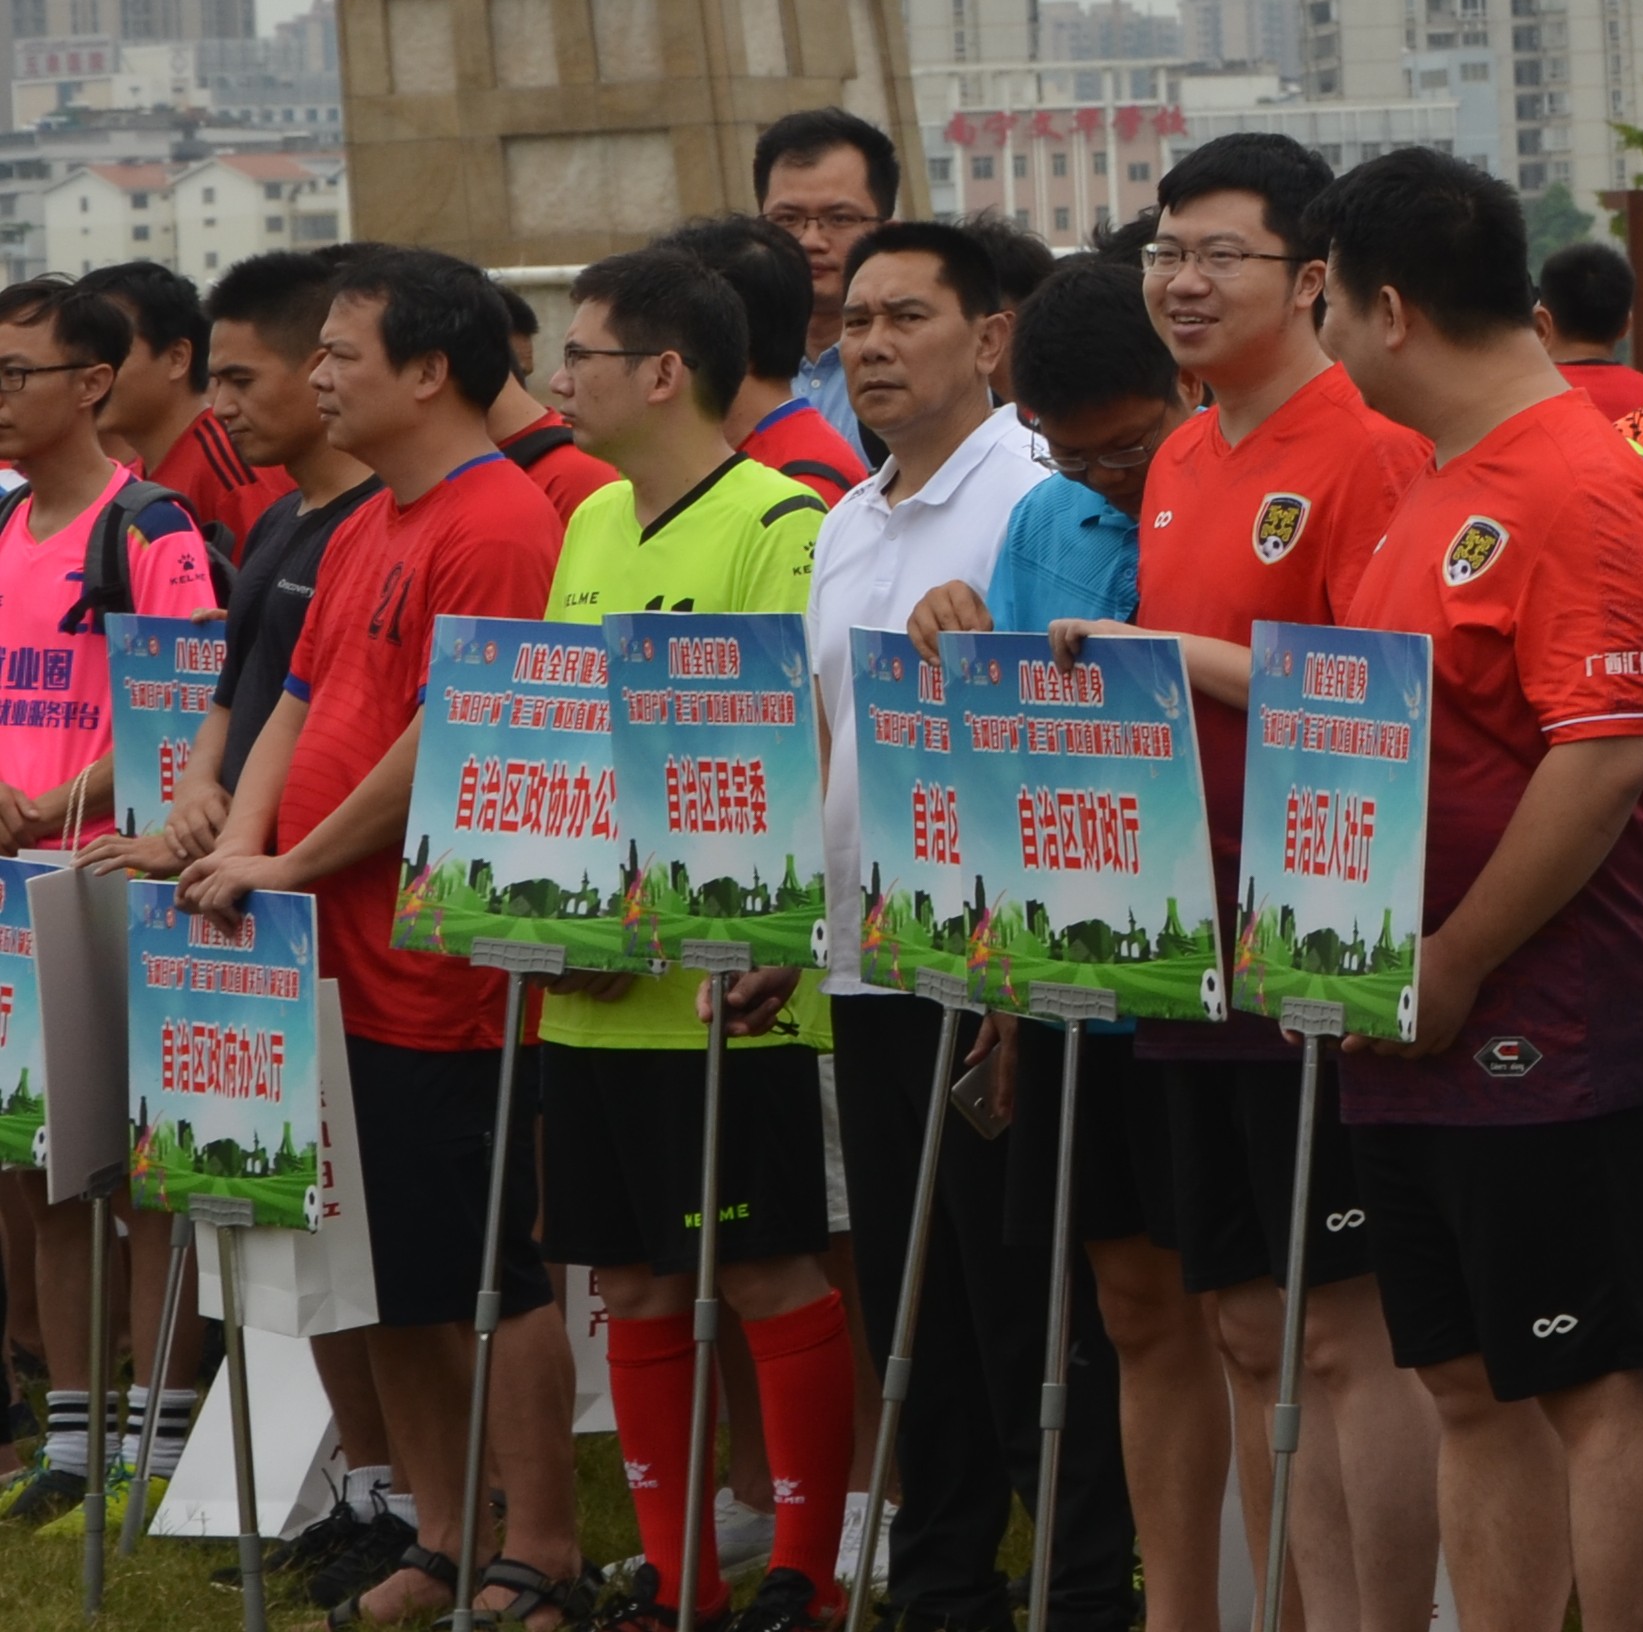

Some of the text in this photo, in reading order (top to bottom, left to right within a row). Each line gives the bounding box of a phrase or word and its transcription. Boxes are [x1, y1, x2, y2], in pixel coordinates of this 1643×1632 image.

[0, 647, 74, 691] 业圈
[512, 643, 609, 688] 八桂全民健身
[669, 637, 740, 679] 八桂全民健身
[1019, 659, 1104, 707] 八桂全民健身
[1303, 652, 1369, 704] 八桂全民健身
[454, 753, 619, 842] 自治区政协办公
[665, 754, 768, 835] 自治区民宗委
[1017, 784, 1141, 875] 自治区财政厅
[1284, 783, 1376, 883] 自治区人社厅
[162, 1017, 285, 1103] 自治区政府办公厅
[684, 1202, 750, 1228] KEME
